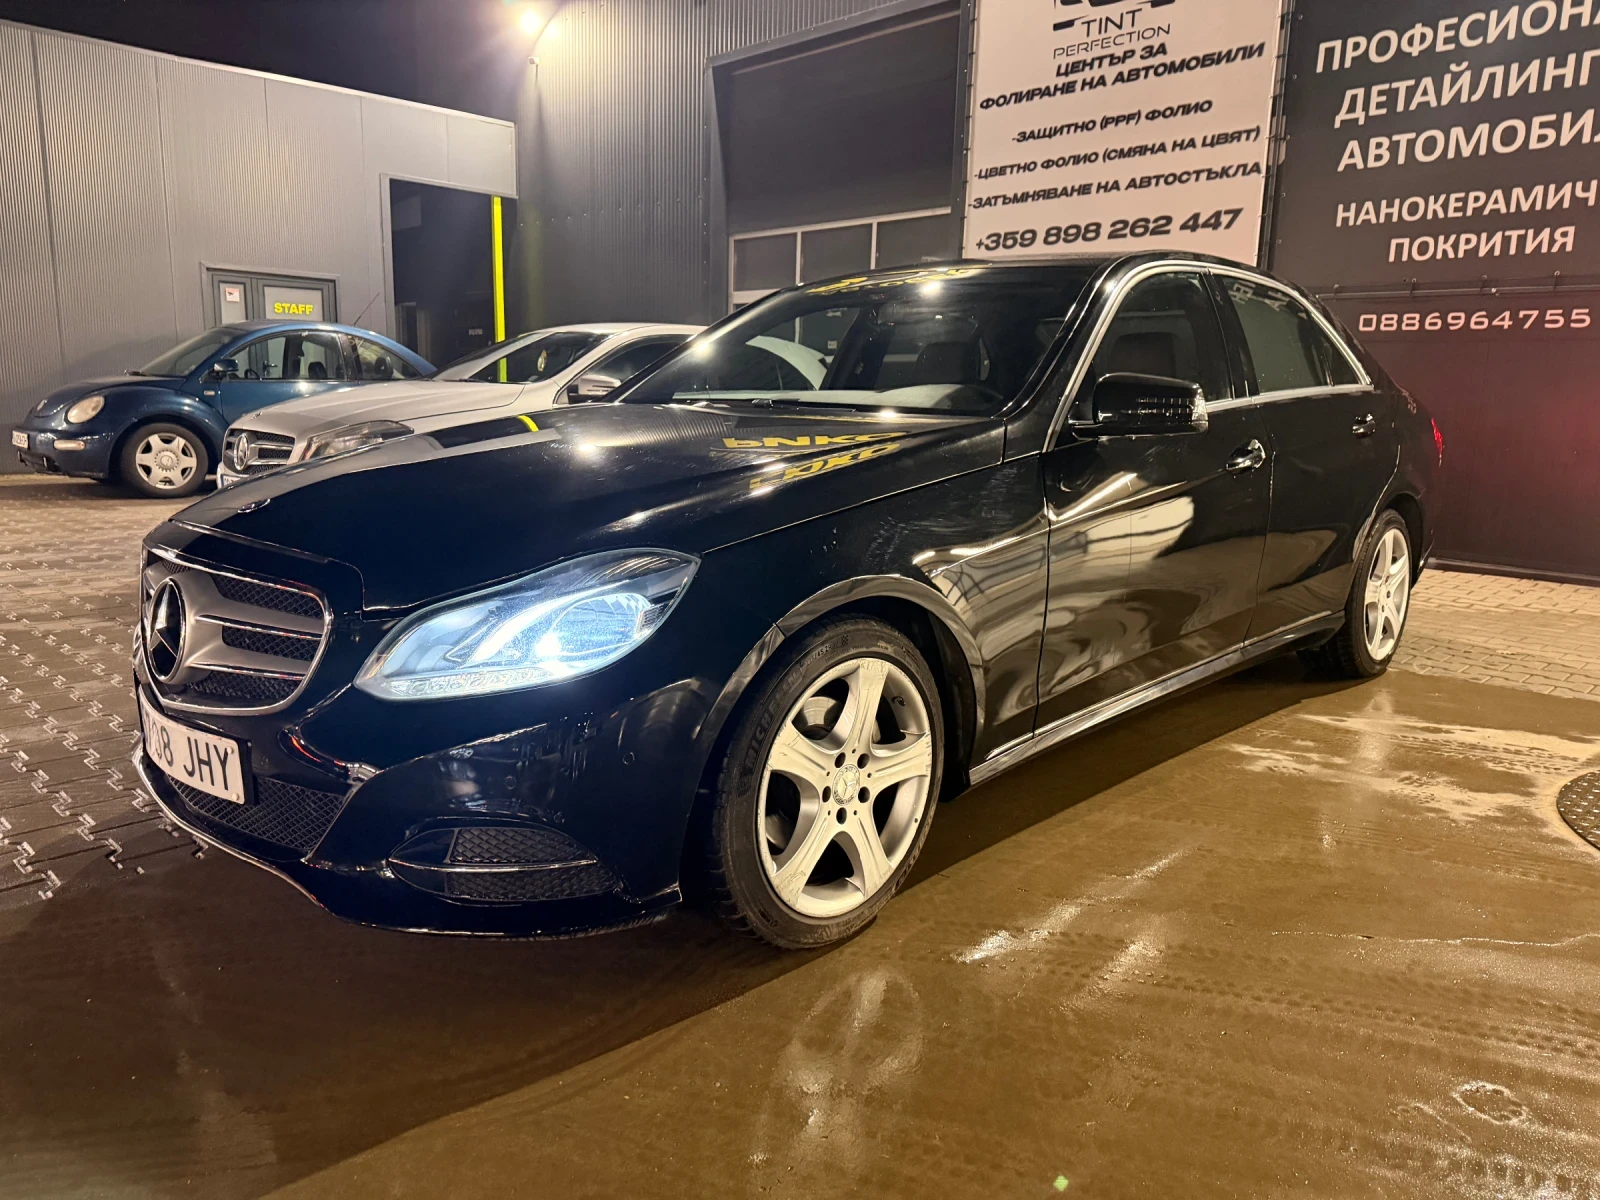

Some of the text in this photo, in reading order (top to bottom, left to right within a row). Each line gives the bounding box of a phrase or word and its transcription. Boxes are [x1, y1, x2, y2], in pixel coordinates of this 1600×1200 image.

[1053, 23, 1170, 59] PERFECTION
[1081, 8, 1142, 37] TINT
[1316, 0, 1600, 73] ПРОФЕСИОН
[980, 42, 1266, 110] ФОЛИРАНЕ НА АВТОМОБИЛИ
[1056, 42, 1167, 77] ЦЕНТЪР ЗА
[1012, 100, 1213, 142] -ЗАЩИТНО (PPF) ФОЛИО
[1337, 109, 1600, 172] АВТОМОБИ
[974, 125, 1261, 179] -ЦВЕТНО ФОЛИО (СМЯНА НА ЦВЯТ)
[968, 162, 1262, 209] -ЗАТЪМНЯВАНЕ НА АВТОСТЪКЛА
[976, 208, 1244, 251] +359 898 262 447
[1388, 226, 1576, 262] ПОКРИТИЯ
[274, 303, 313, 315] STAFF
[1358, 309, 1592, 331] 0886964755
[183, 736, 229, 791] JHY
